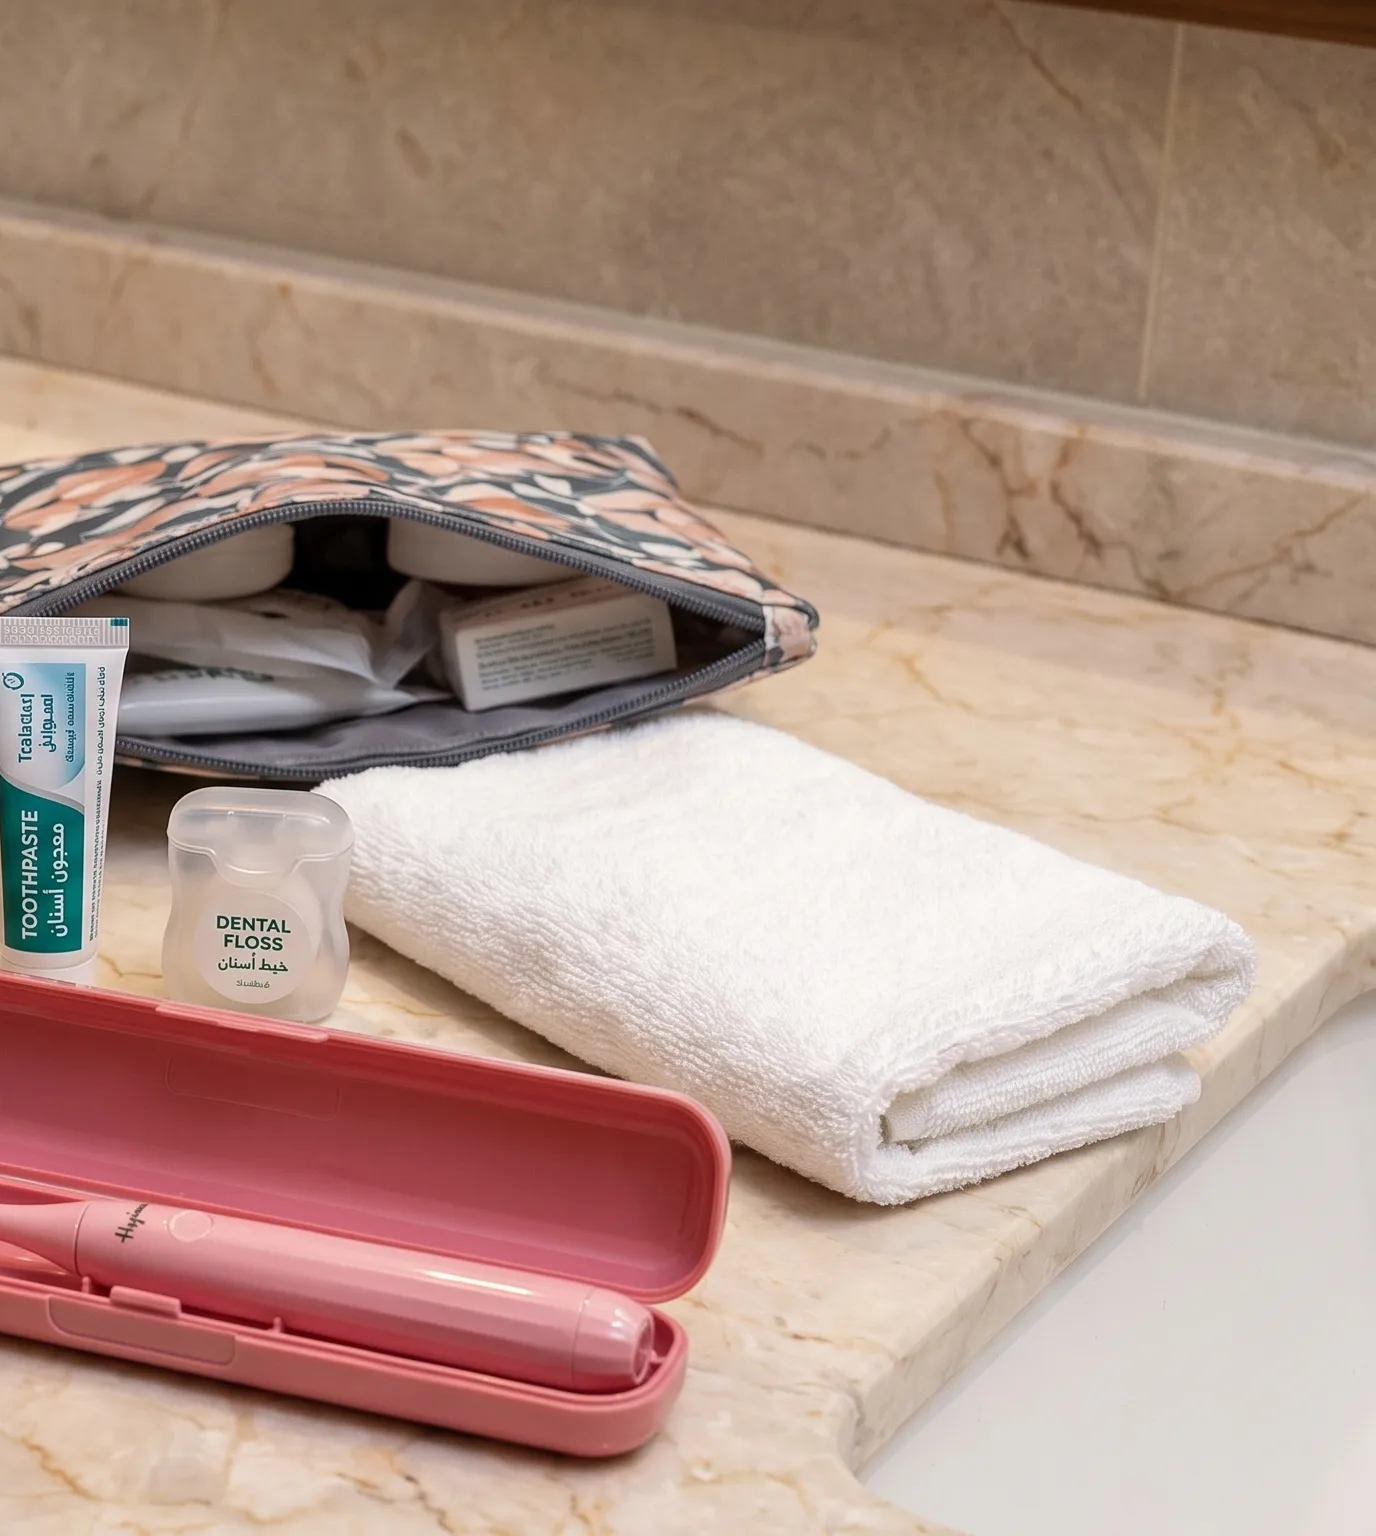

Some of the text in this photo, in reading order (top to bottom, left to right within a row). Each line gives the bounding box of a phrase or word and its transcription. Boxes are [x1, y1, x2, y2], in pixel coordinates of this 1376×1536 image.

[20, 810, 39, 940] TOOTHPASTE
[43, 823, 69, 937] معجون أسنان
[215, 915, 291, 934] DENTAL
[223, 934, 284, 952] FLOSS
[218, 952, 288, 973] خيط أسنان
